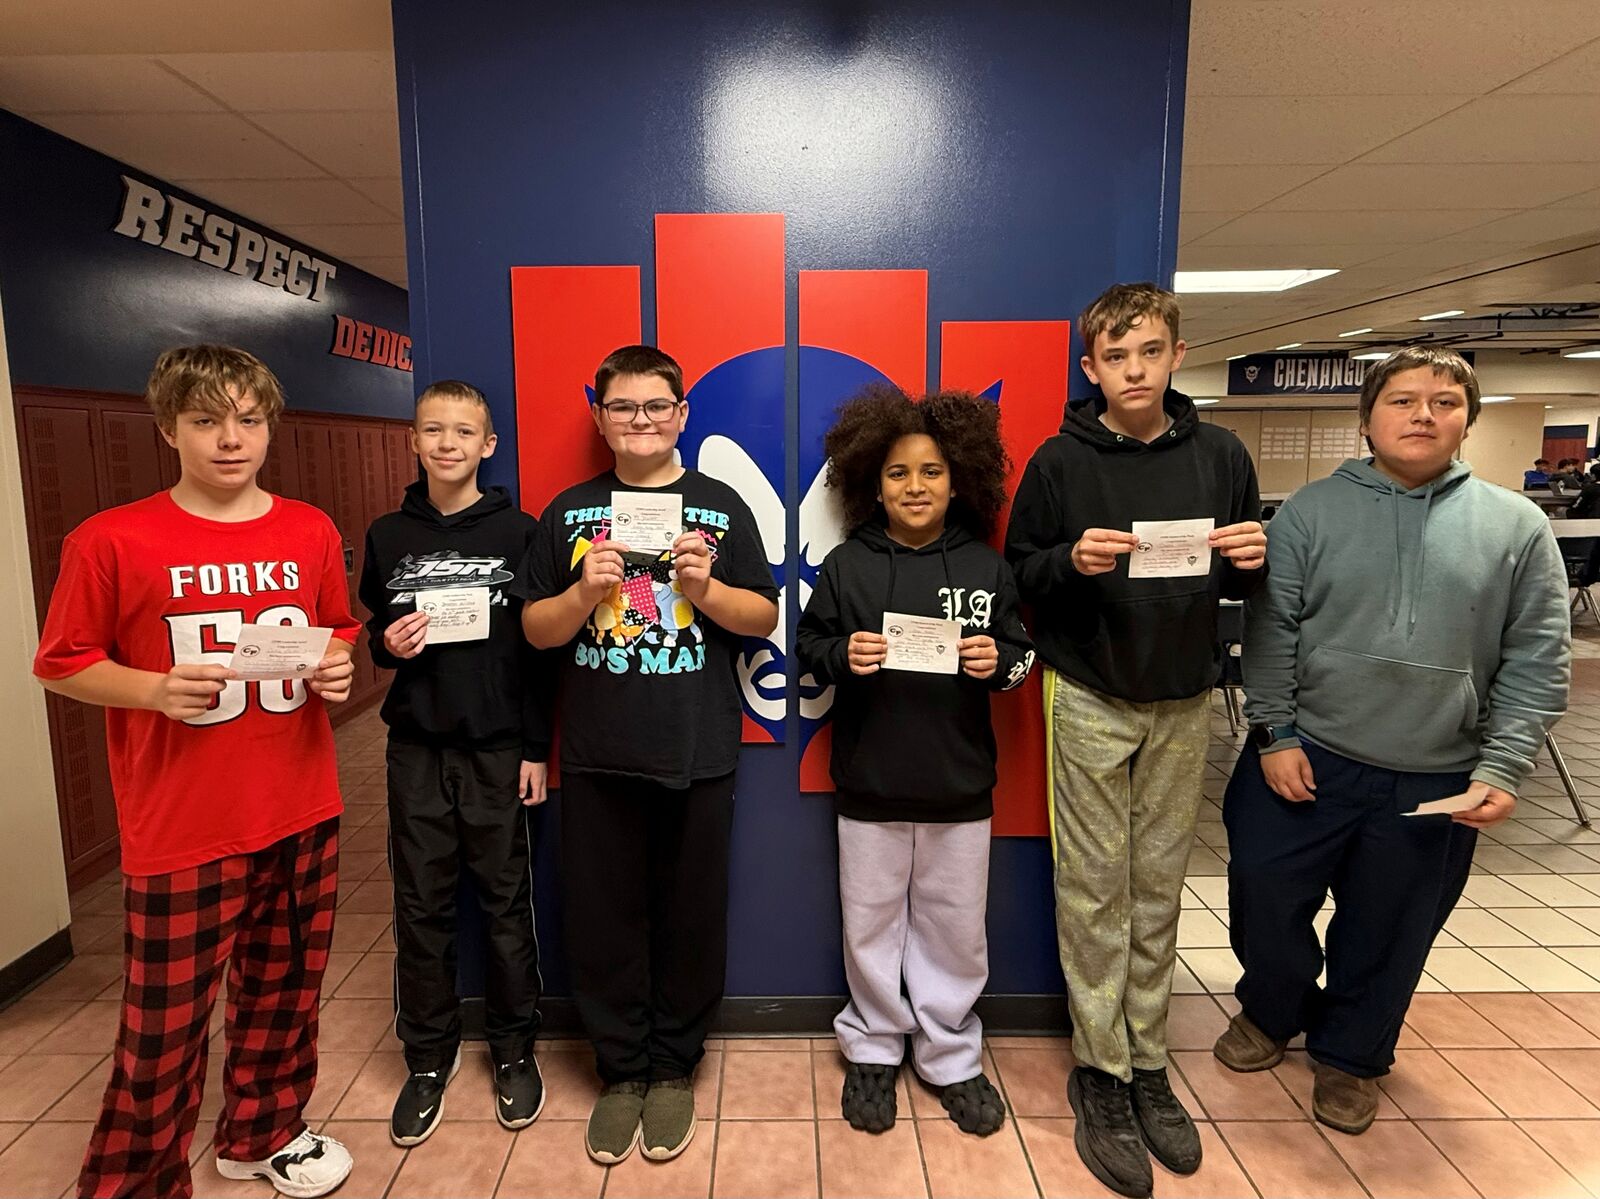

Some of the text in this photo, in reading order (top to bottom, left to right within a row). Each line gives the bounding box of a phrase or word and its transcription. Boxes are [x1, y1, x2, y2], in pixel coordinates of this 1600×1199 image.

[113, 174, 336, 302] RESPECT
[331, 314, 413, 372] DEDIC
[564, 506, 730, 531] THIS THE
[168, 561, 300, 598] FORKS
[400, 559, 504, 580] JSR
[937, 587, 996, 629] LA
